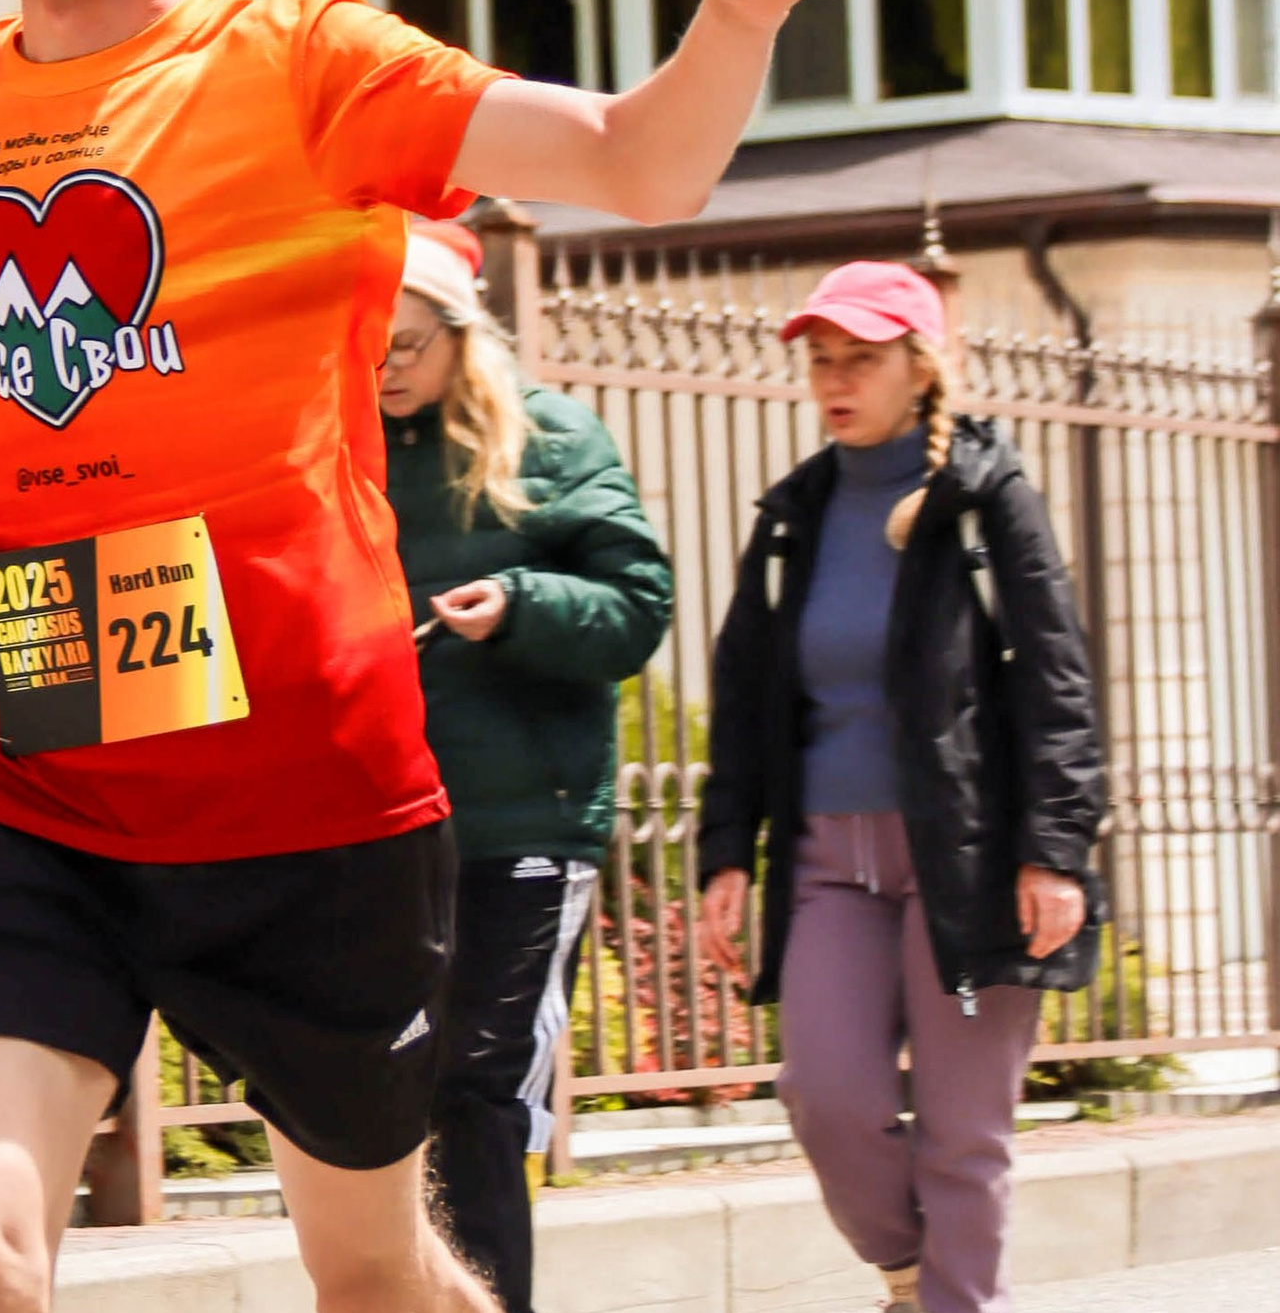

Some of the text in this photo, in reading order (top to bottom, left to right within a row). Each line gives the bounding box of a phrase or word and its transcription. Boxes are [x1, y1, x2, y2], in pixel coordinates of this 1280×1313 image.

[4, 133, 48, 149] моём
[51, 124, 109, 144] сердце
[31, 155, 41, 166] и
[45, 147, 104, 164] солнце
[49, 317, 185, 393] Свои
[16, 455, 135, 492] @vse_svoi_
[109, 562, 195, 594] Hard Run
[108, 605, 214, 674] 224
[0, 640, 91, 675] BACKYARD
